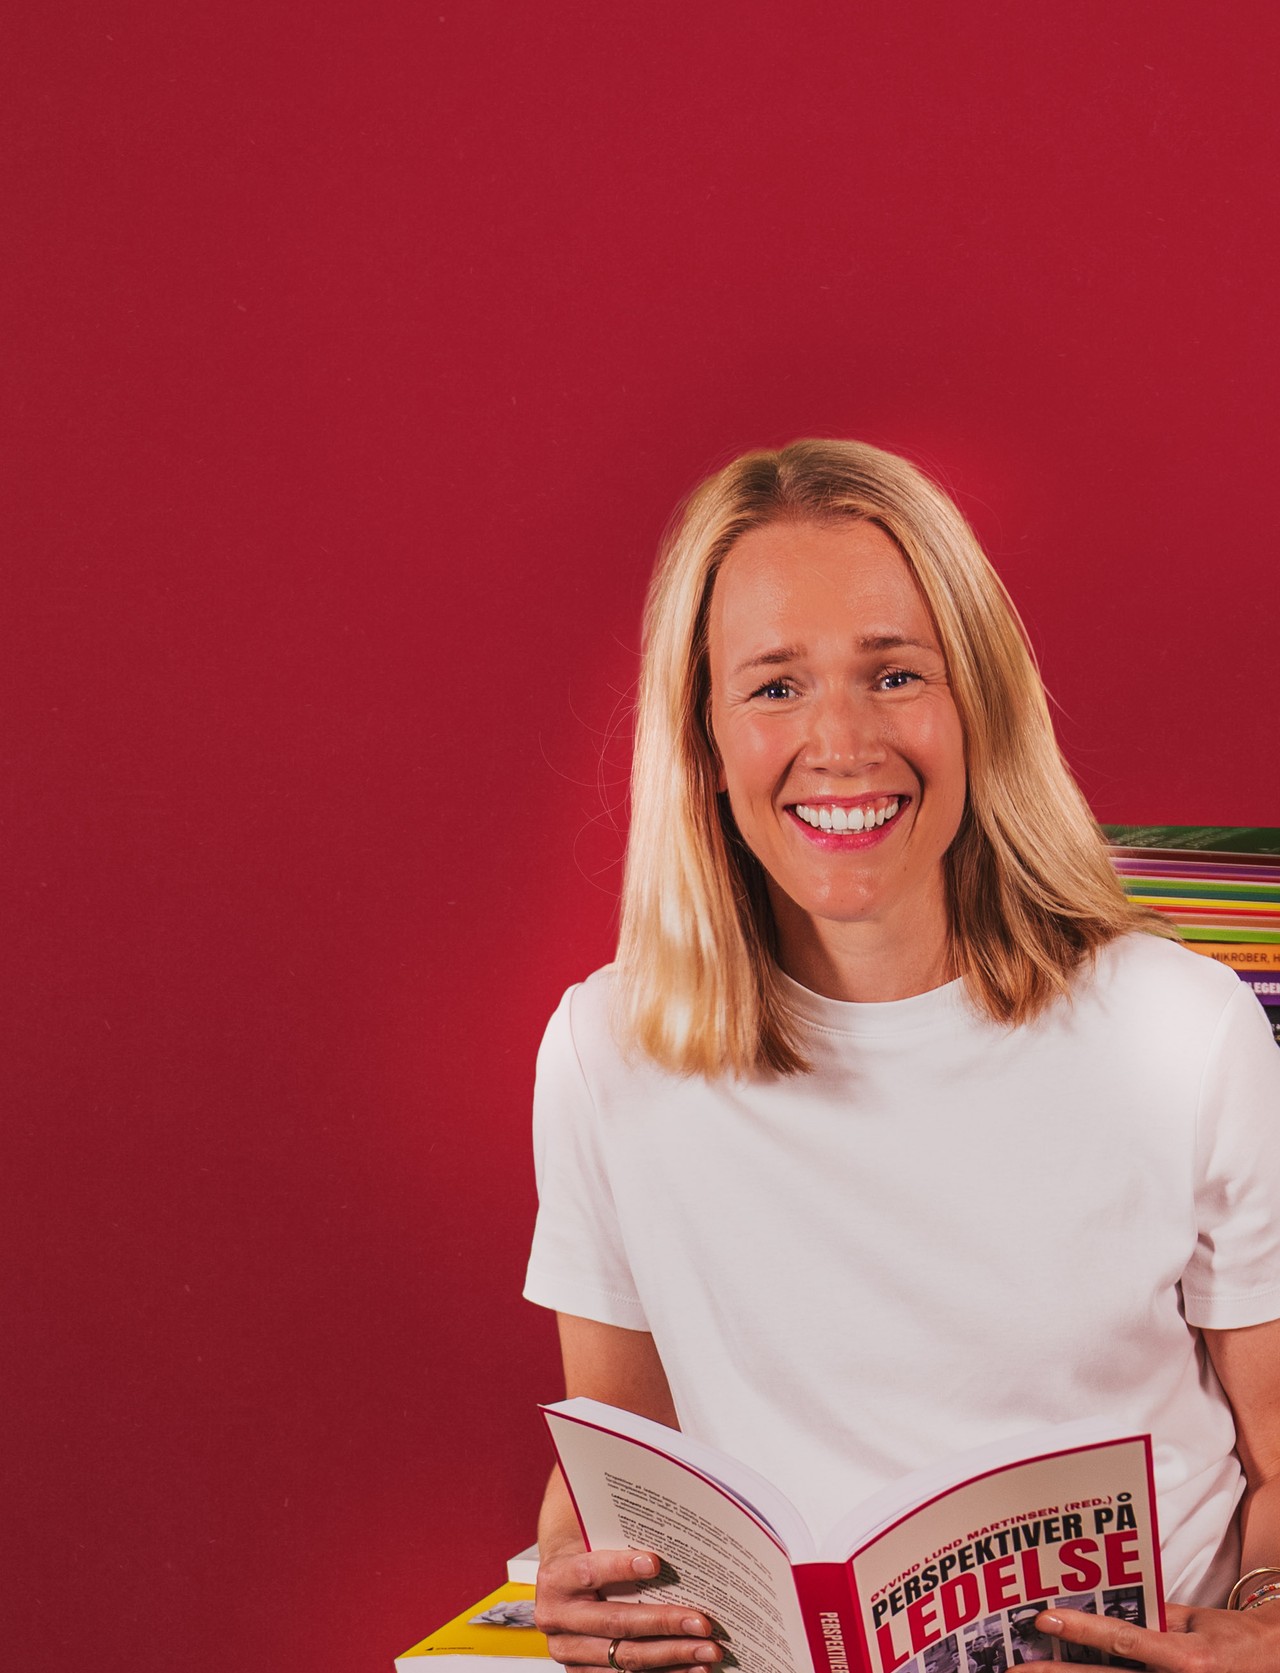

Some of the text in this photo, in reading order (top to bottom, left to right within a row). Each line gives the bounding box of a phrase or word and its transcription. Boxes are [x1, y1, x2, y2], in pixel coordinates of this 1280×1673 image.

[1211, 952, 1270, 964] MIKROBER,
[870, 1495, 1113, 1603] ØYVIND LUND MARTINSEN (RED.)
[871, 1491, 1138, 1630] PERSPEKTIVER PÅ
[875, 1529, 1144, 1673] LEDELSE
